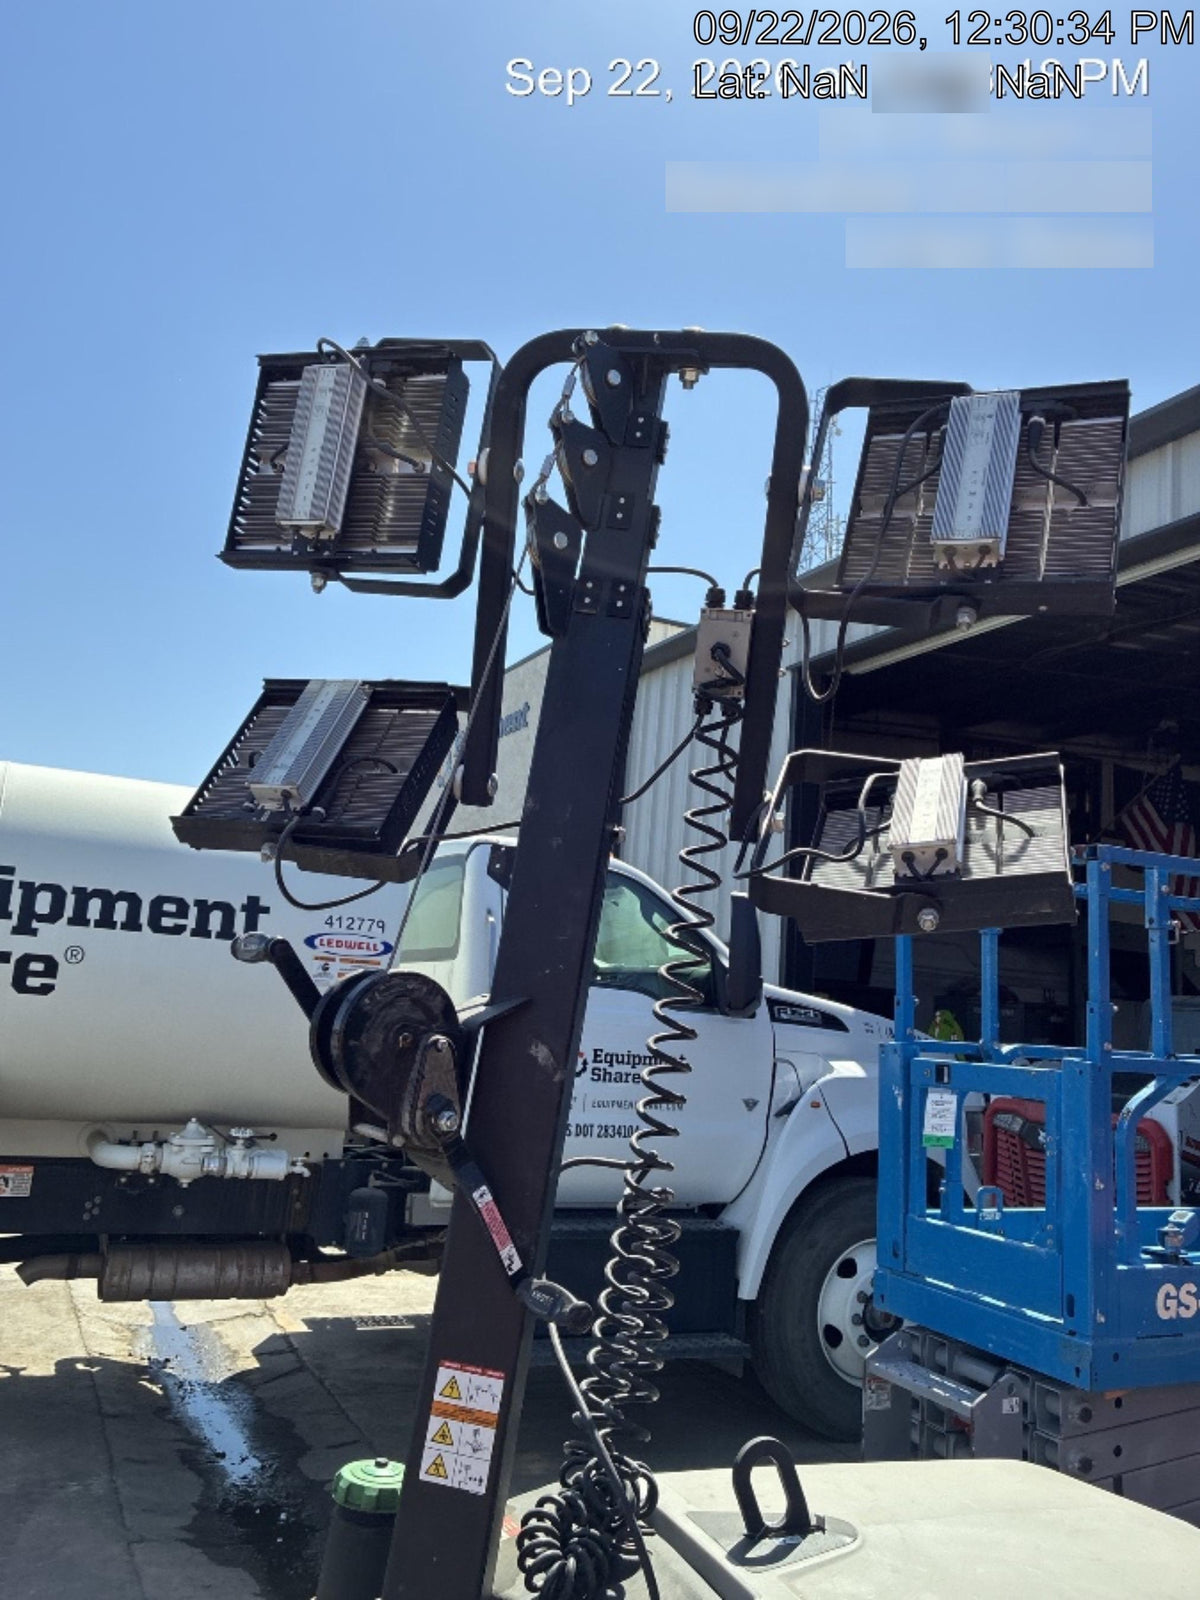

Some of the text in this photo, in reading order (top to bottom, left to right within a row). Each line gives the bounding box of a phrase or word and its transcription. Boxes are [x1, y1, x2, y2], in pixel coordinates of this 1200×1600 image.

[324, 914, 386, 934] 412779
[319, 938, 381, 952] LEDWELL
[590, 1067, 641, 1084] Share
[575, 1123, 594, 1137] DOT
